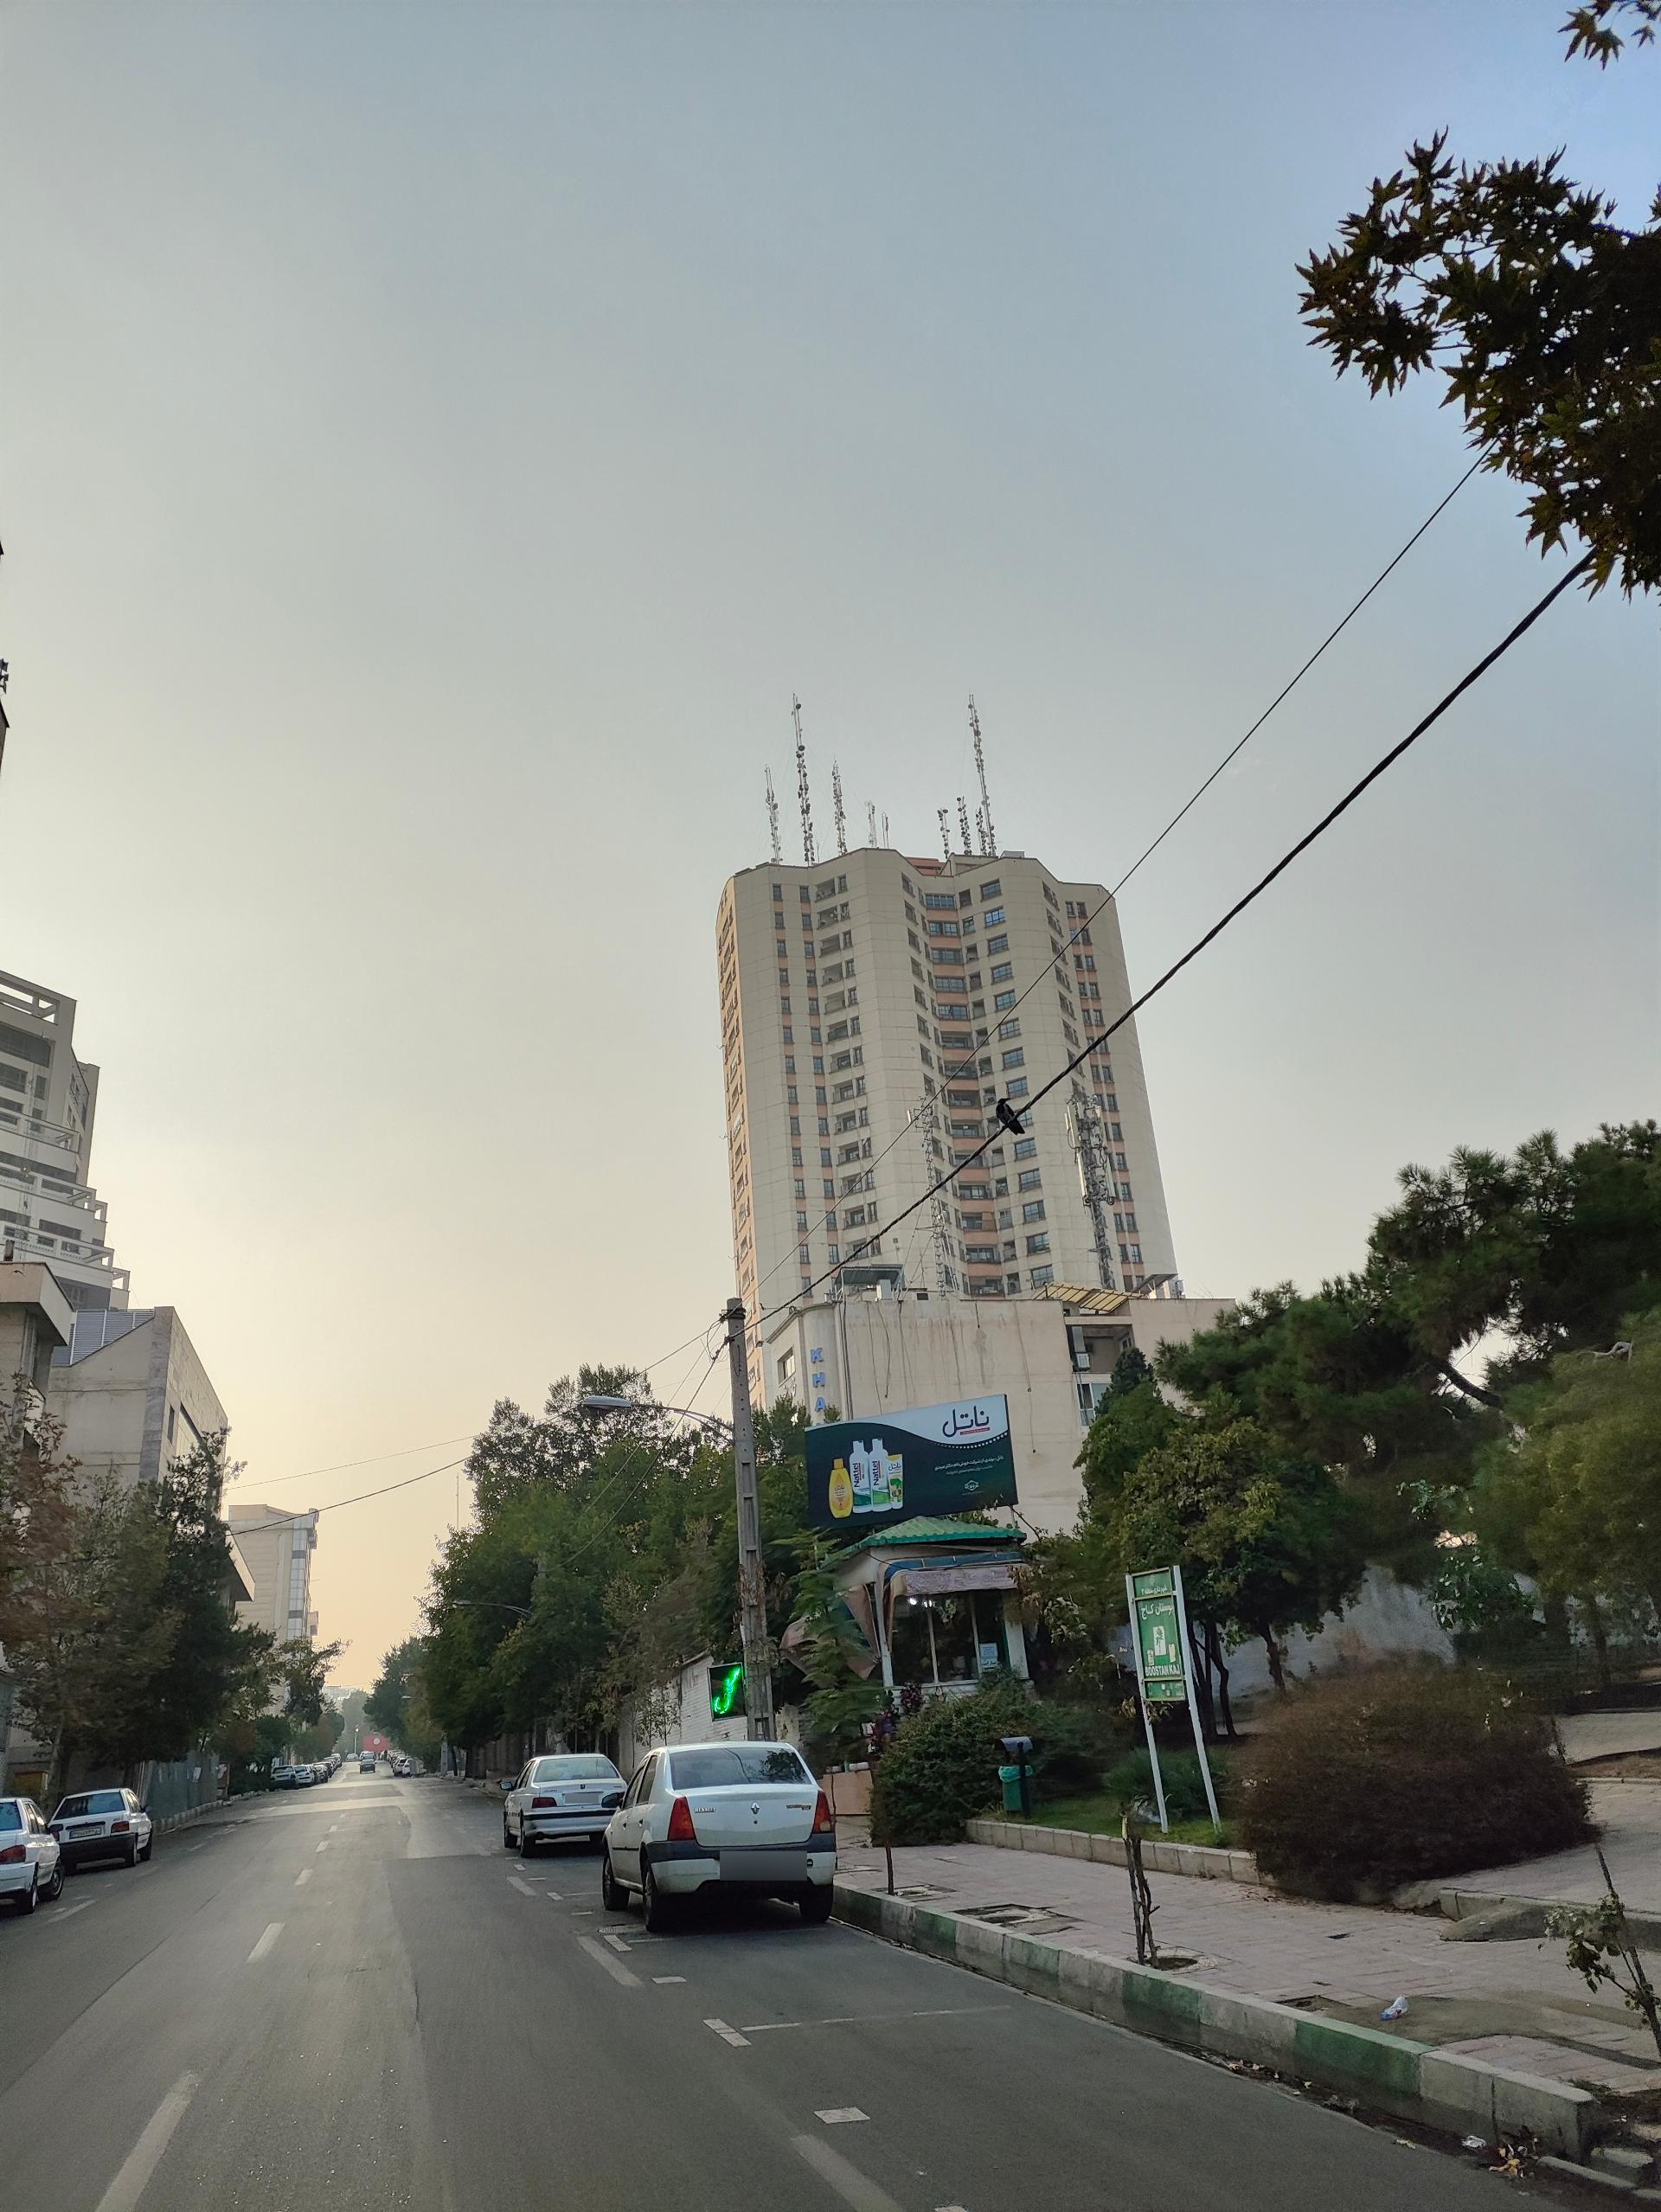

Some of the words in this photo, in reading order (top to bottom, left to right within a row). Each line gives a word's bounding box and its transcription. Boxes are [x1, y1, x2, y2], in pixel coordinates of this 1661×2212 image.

[810, 1347, 825, 1427] KHA
[942, 1405, 990, 1438] ناتل
[852, 1463, 861, 1488] Nattel
[871, 1460, 880, 1486] Nattel
[1141, 1603, 1154, 1620] کاج
[1145, 1664, 1169, 1677] BOOSTAN
[1169, 1664, 1181, 1676] KAJ
